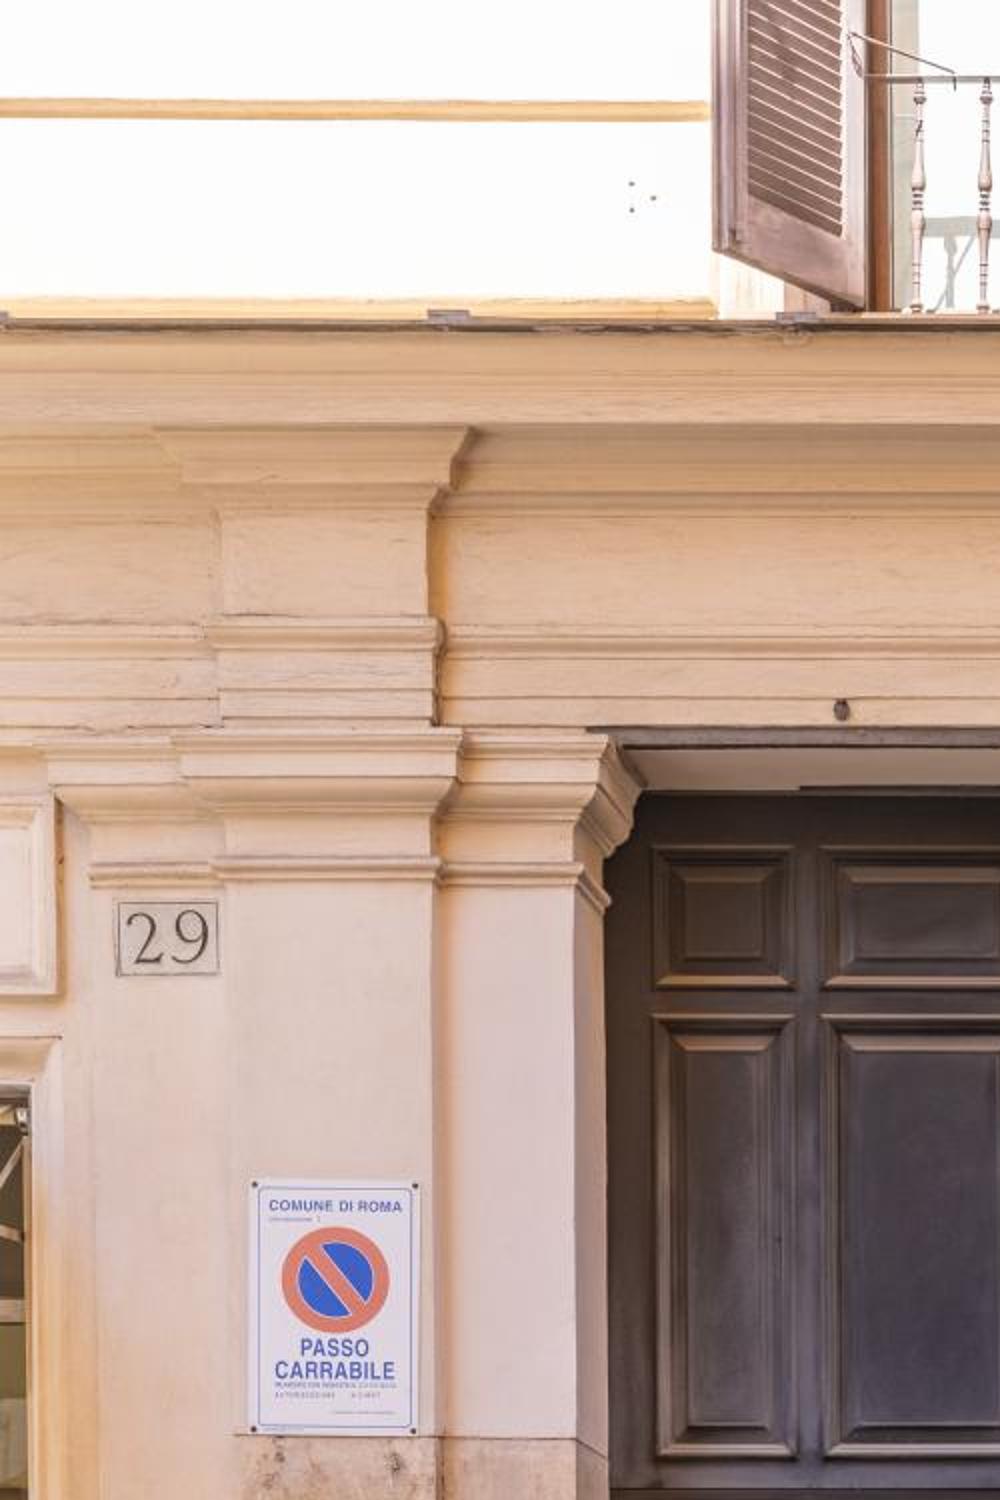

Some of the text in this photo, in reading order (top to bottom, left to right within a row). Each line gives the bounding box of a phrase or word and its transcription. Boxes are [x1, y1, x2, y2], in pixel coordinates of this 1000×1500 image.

[127, 909, 208, 964] 29
[269, 1199, 402, 1213] COMUNE DI ROMA
[301, 1338, 369, 1357] PASSO
[275, 1361, 395, 1380] CARRABILE
